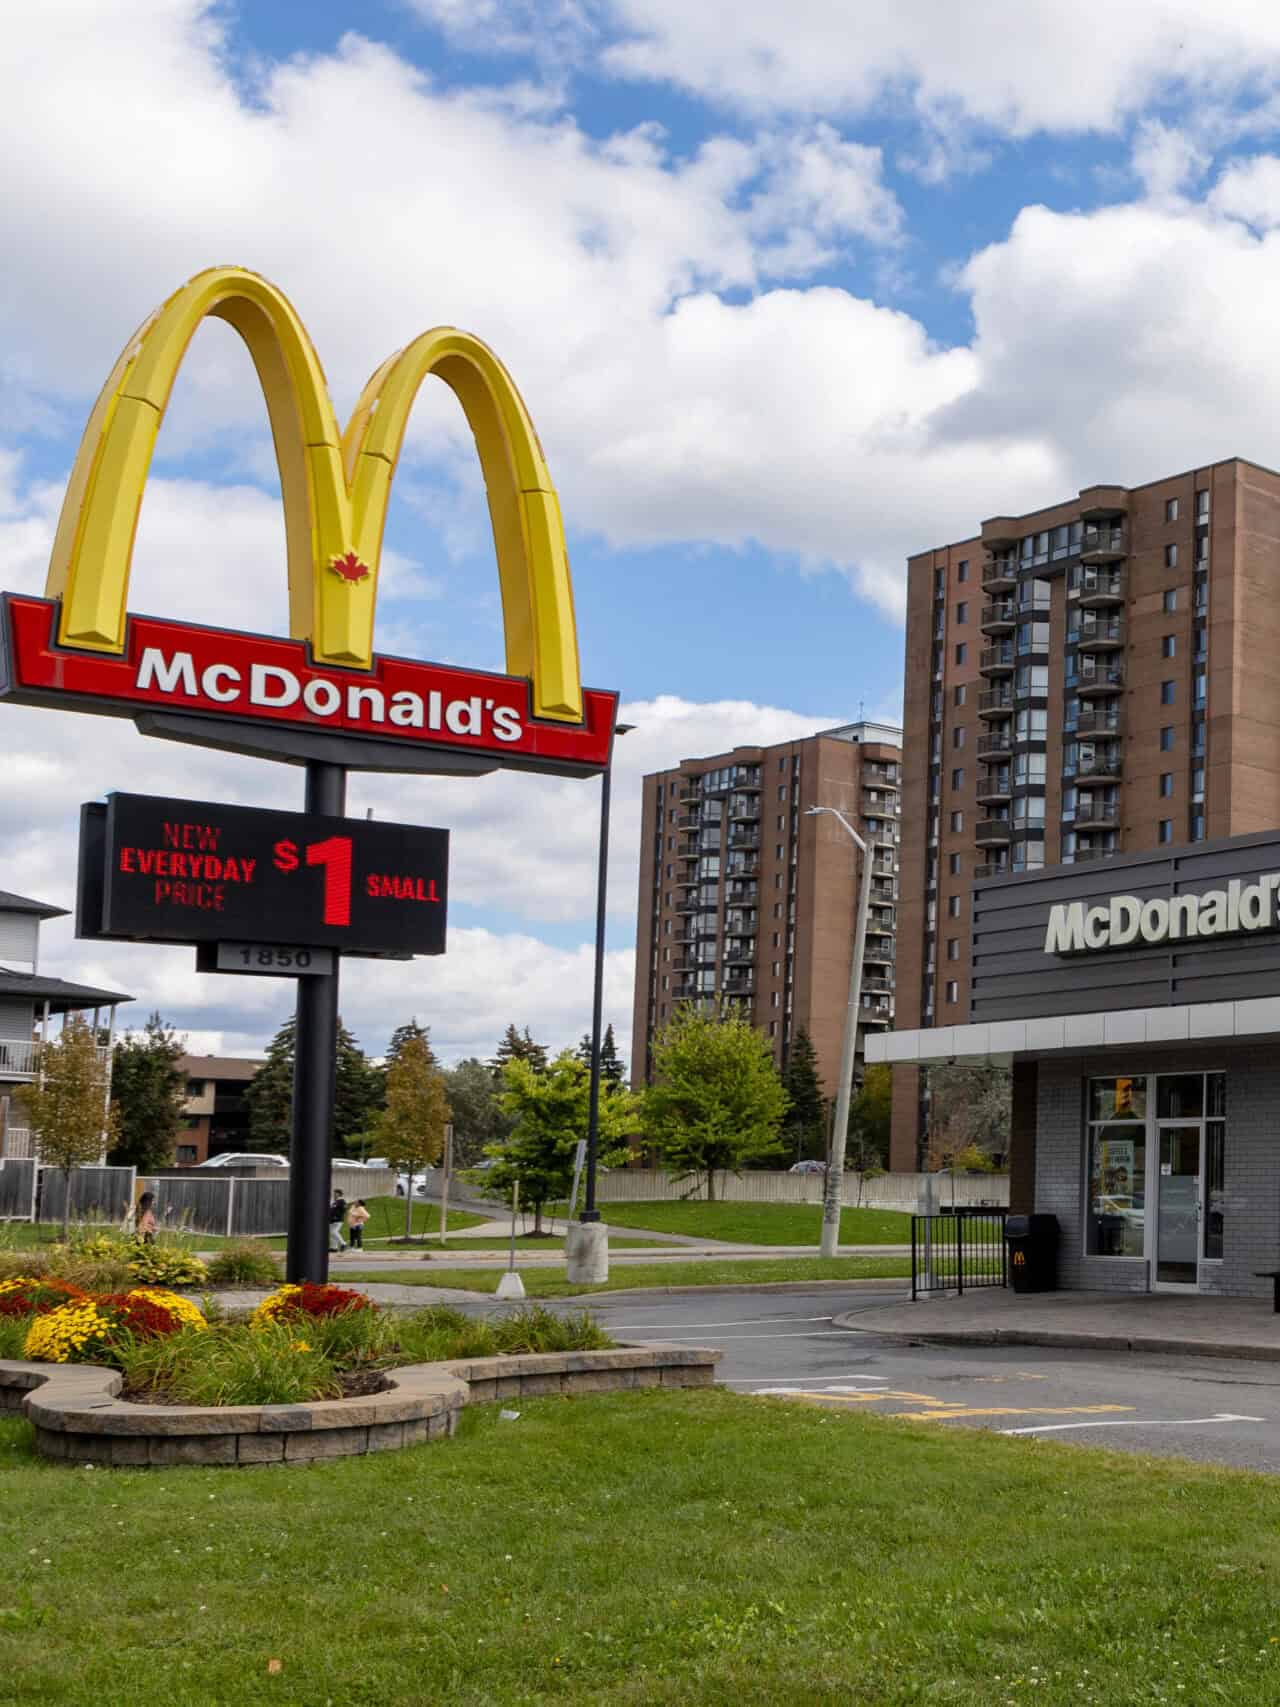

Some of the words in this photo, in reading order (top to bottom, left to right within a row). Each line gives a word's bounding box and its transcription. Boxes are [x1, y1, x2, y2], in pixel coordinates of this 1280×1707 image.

[135, 647, 523, 742] McDonald's
[162, 821, 222, 851] NEW
[119, 847, 257, 883] EVERYDAY
[154, 879, 225, 912] PRICE
[366, 873, 440, 903] SMALL
[239, 948, 312, 969] 1850
